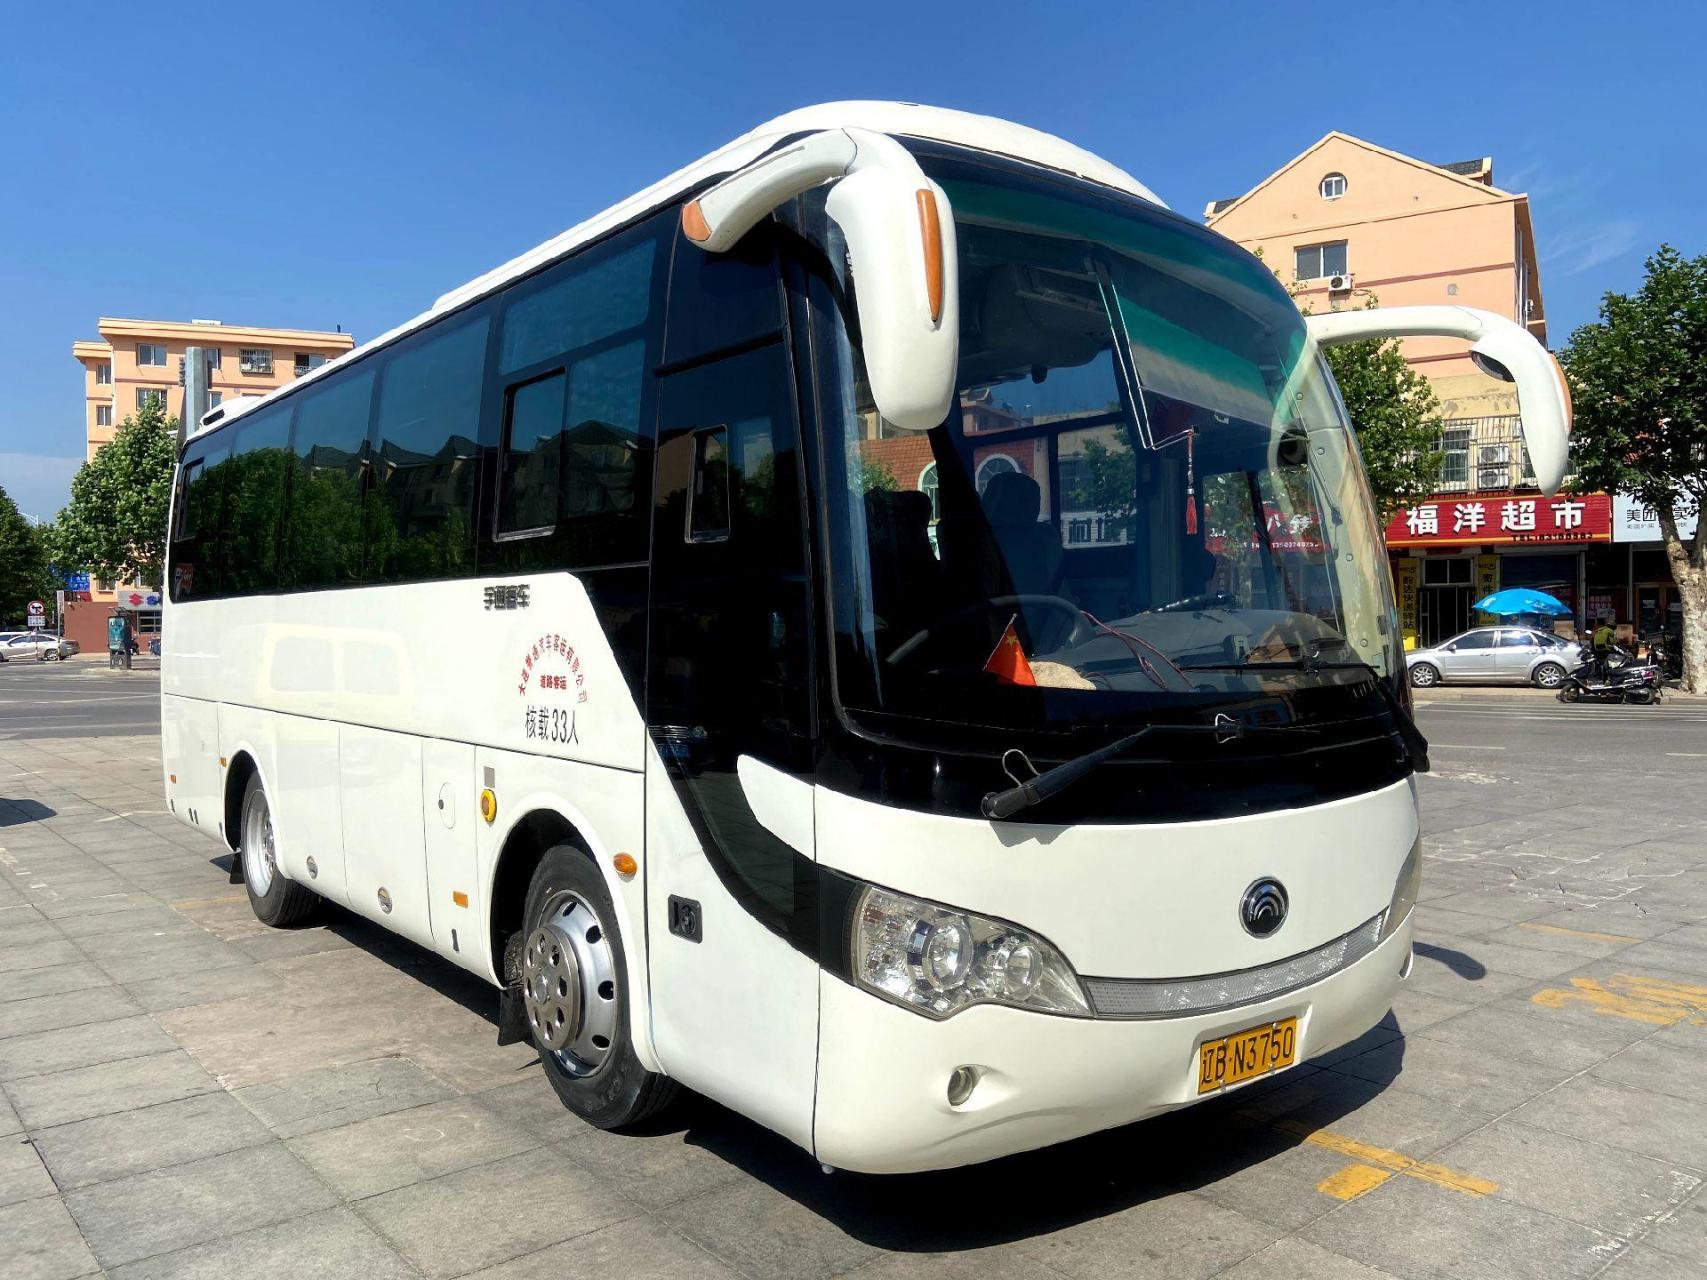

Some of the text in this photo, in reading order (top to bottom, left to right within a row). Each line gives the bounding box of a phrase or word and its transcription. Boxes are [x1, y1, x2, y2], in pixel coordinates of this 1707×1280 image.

[1406, 500, 1586, 536] 福洋超市
[1626, 506, 1688, 522] 美团卖
[525, 704, 579, 746] 核载33人
